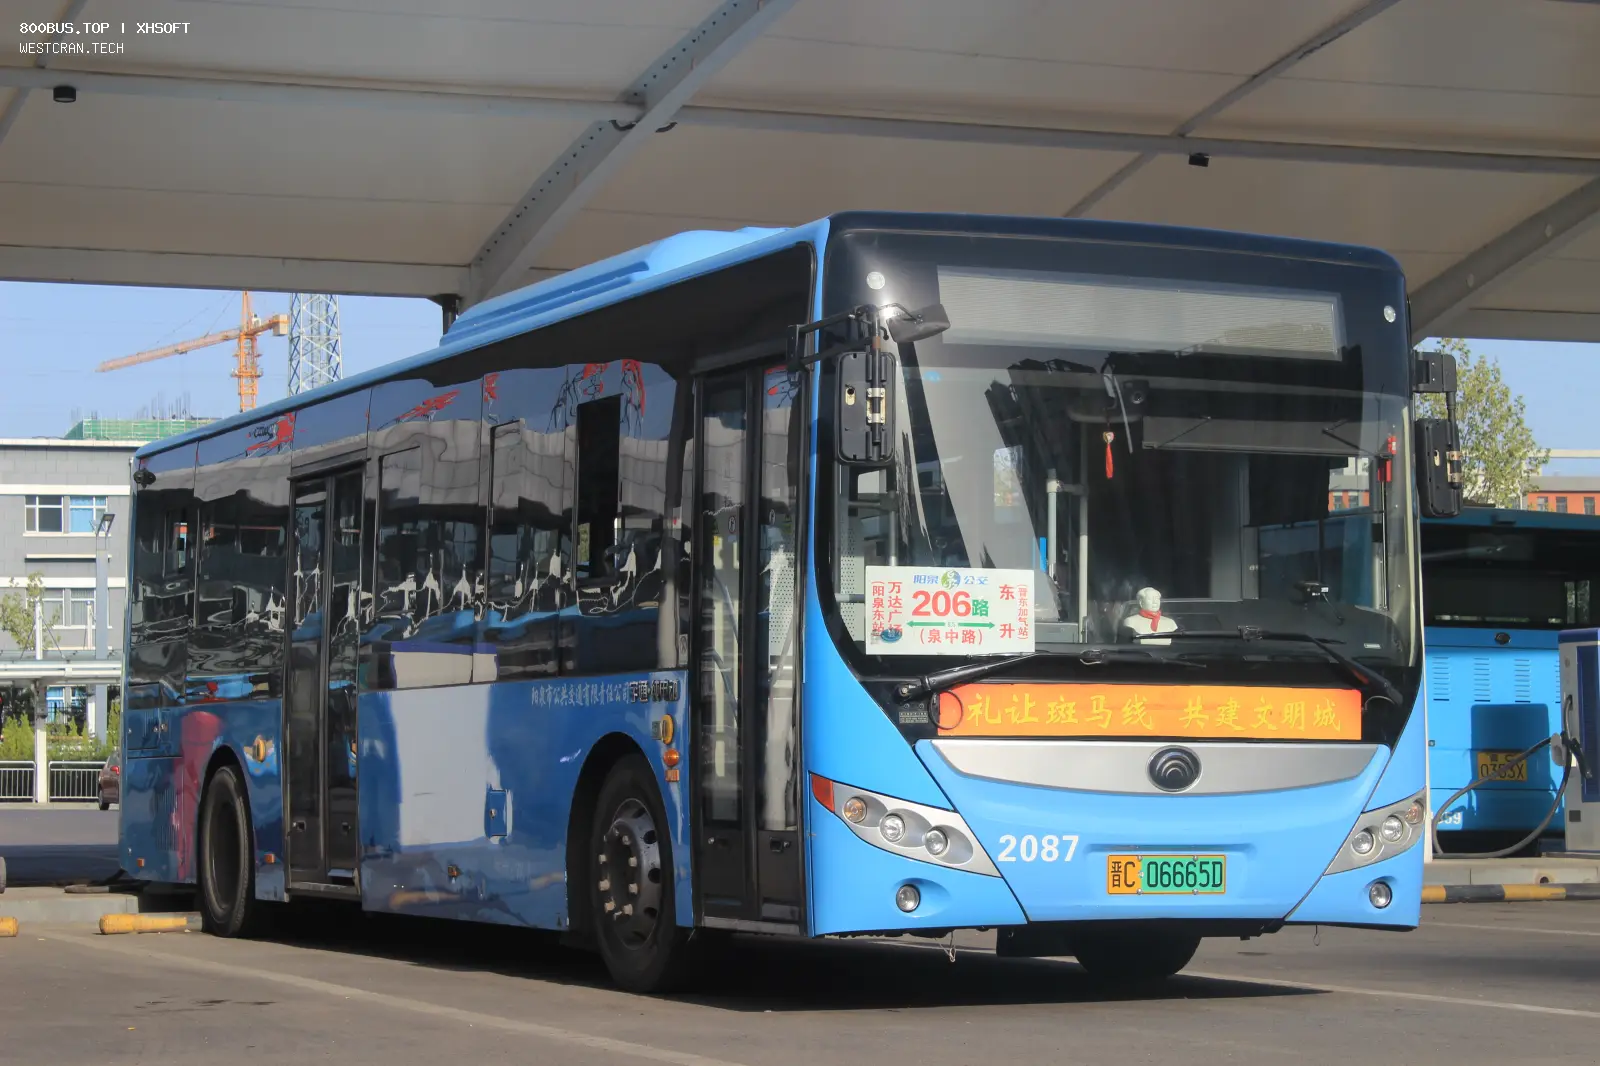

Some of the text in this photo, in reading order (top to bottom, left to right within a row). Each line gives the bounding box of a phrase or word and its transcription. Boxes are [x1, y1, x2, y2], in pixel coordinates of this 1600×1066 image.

[913, 575, 989, 585] 阳泉 公交
[911, 590, 989, 617] 206路
[920, 628, 983, 645] (泉中路)
[966, 693, 1342, 732] 礼让斑马线 共建文明城
[997, 834, 1080, 863] 2087
